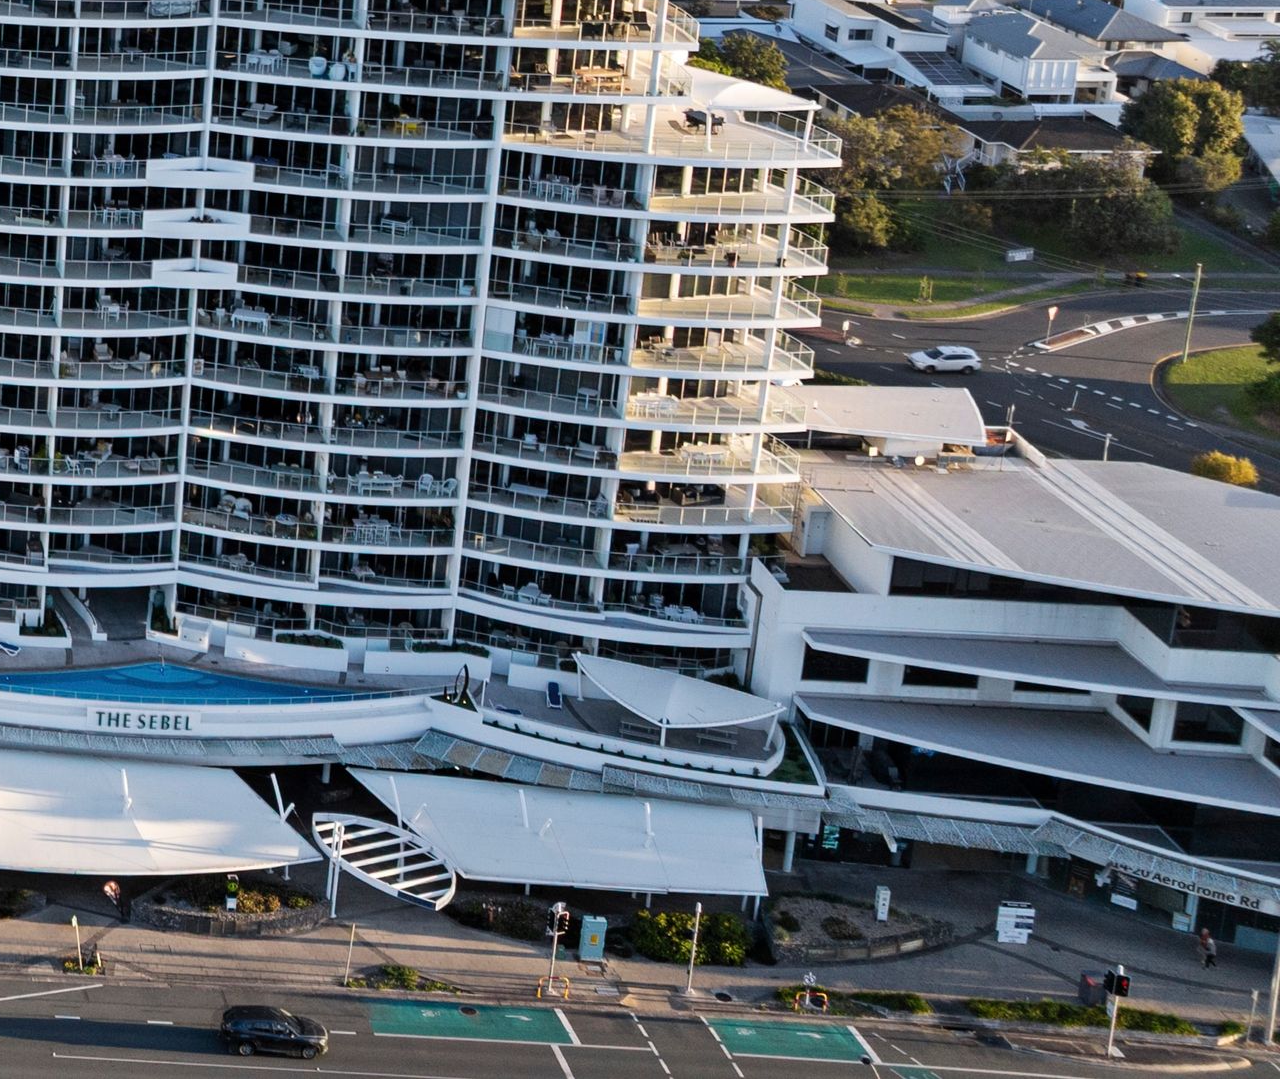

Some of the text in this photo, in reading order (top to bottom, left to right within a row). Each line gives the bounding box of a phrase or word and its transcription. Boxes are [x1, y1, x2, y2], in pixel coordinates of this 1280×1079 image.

[96, 711, 192, 731] THE SEBEL
[1151, 873, 1236, 903] Aerodrome
[1239, 896, 1261, 910] Rd
